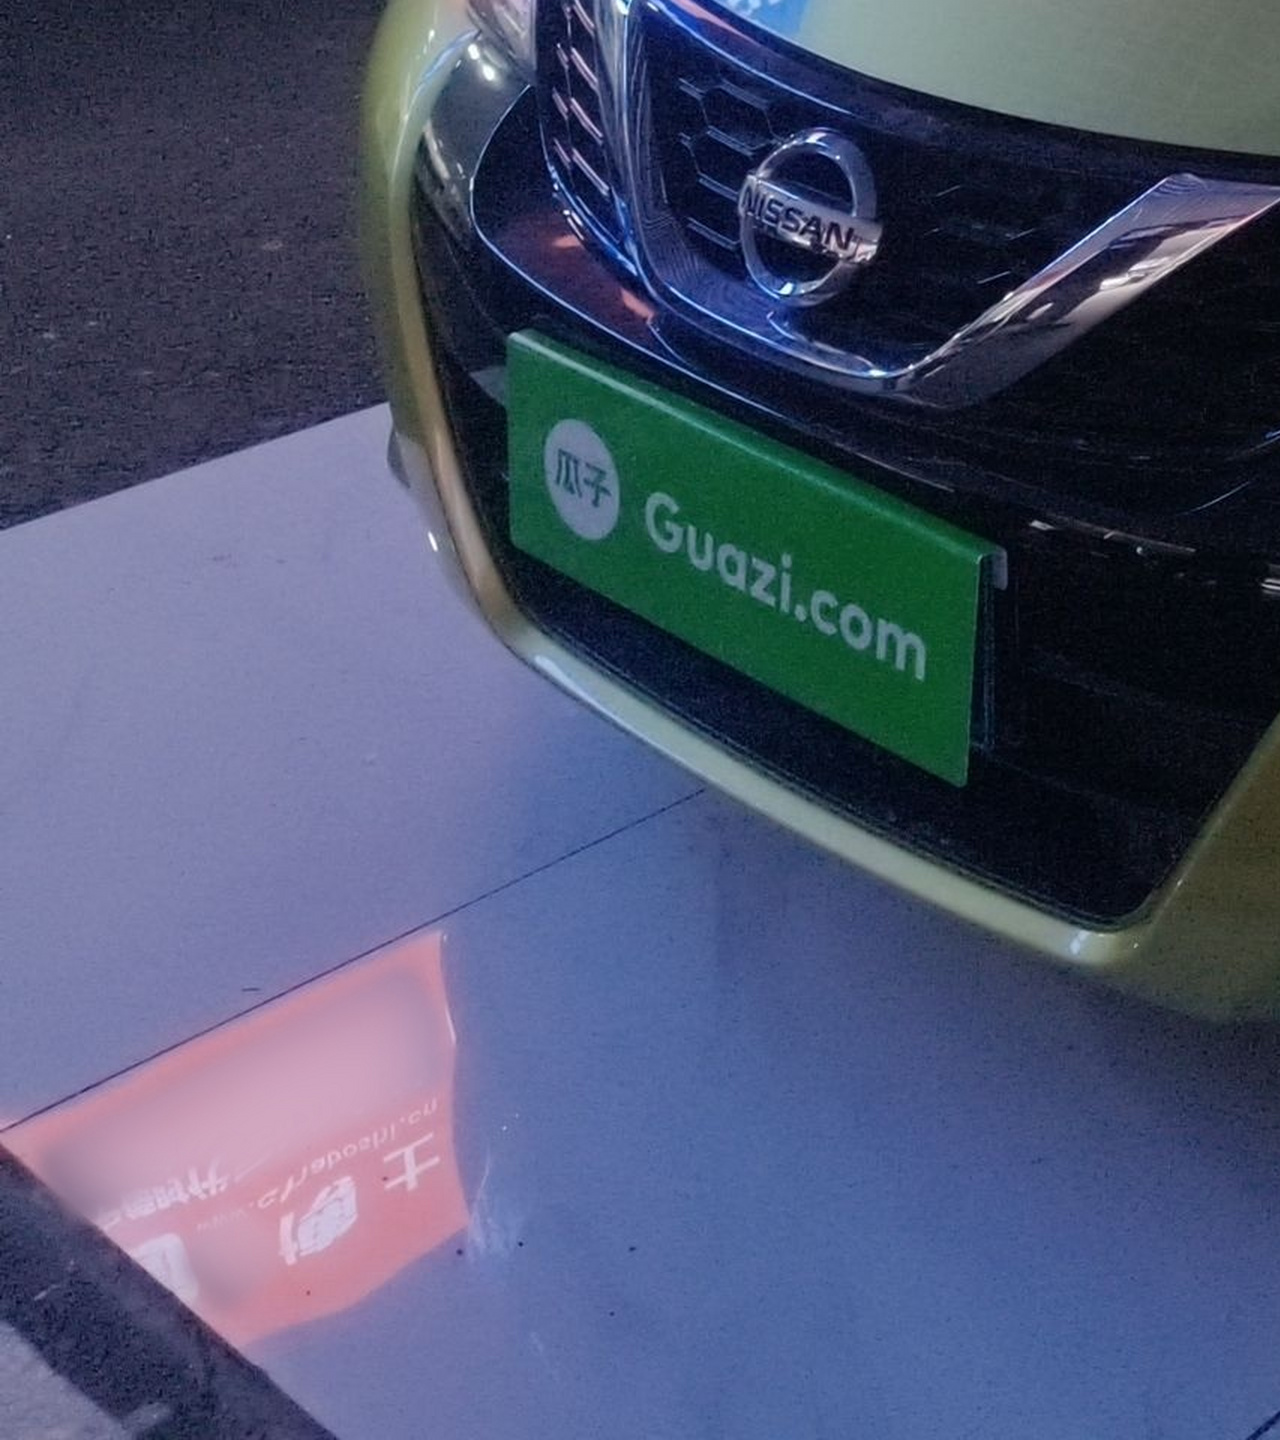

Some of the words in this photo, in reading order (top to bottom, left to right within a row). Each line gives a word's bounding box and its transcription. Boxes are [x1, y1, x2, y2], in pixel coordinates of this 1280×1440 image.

[742, 182, 855, 252] NISSAN
[554, 448, 611, 509] 瓜子
[645, 491, 926, 680] Guazi.com
